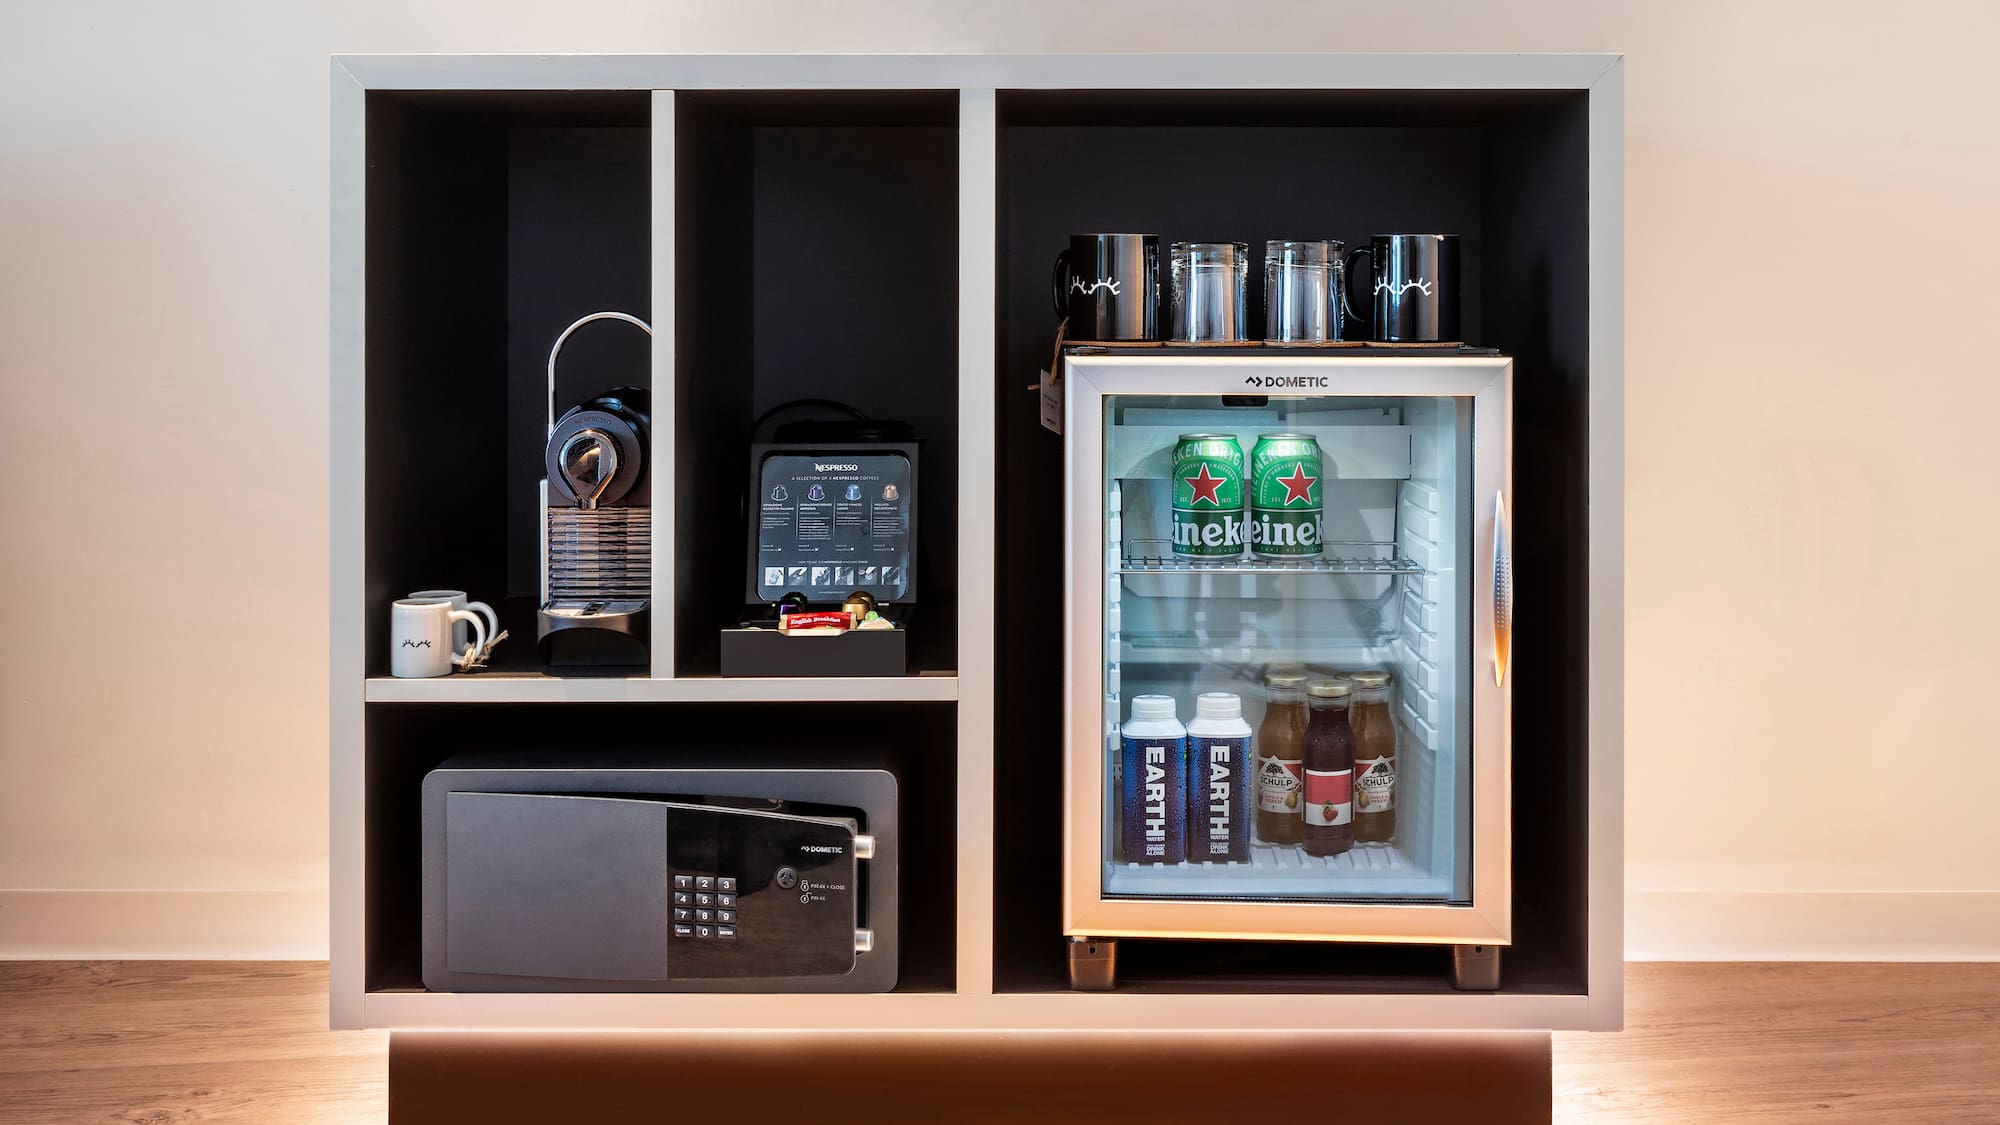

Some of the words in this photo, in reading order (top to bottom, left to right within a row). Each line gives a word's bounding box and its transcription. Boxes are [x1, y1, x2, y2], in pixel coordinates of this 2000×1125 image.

[1265, 376, 1329, 388] DOMETIC
[1172, 442, 1203, 469] EKEN
[815, 463, 858, 473] NESPRESSO
[791, 617, 813, 625] English
[1146, 746, 1165, 837] EARTH
[1210, 746, 1230, 835] EARTH
[702, 880, 708, 888] 2
[723, 881, 730, 889] 3
[680, 895, 686, 903] 4
[702, 896, 708, 904] 5
[723, 897, 730, 905] 6
[680, 911, 687, 919] 7
[702, 912, 708, 920] 8
[723, 913, 729, 921] 9
[702, 928, 708, 936] 0
